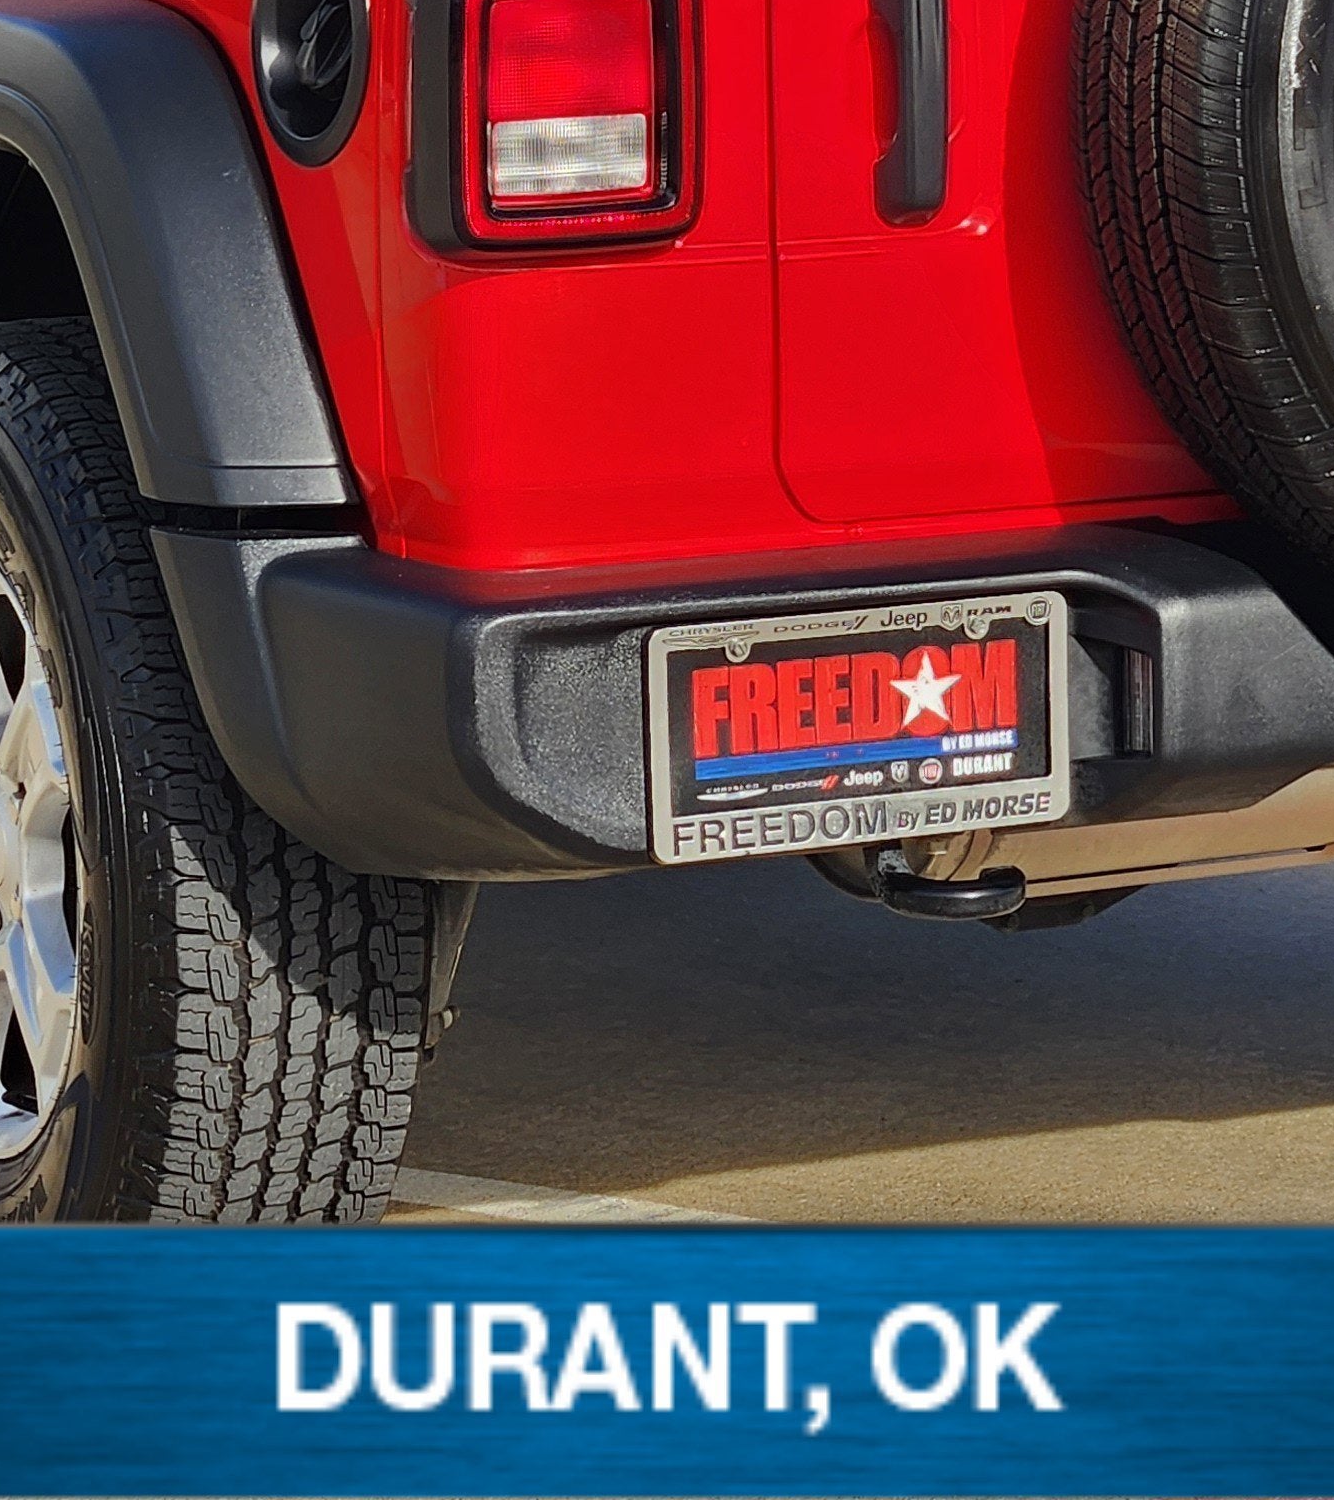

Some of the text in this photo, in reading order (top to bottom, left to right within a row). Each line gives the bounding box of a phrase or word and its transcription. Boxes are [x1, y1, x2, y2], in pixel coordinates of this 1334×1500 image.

[668, 604, 1012, 637] CHRYSLER DODGE Jeep RAM
[692, 638, 1018, 759] FREEDOM
[974, 729, 1014, 747] MORSE
[843, 769, 884, 787] Jeep
[952, 751, 1014, 777] DURANT
[672, 790, 1052, 857] FREEDOM By ED MORSE
